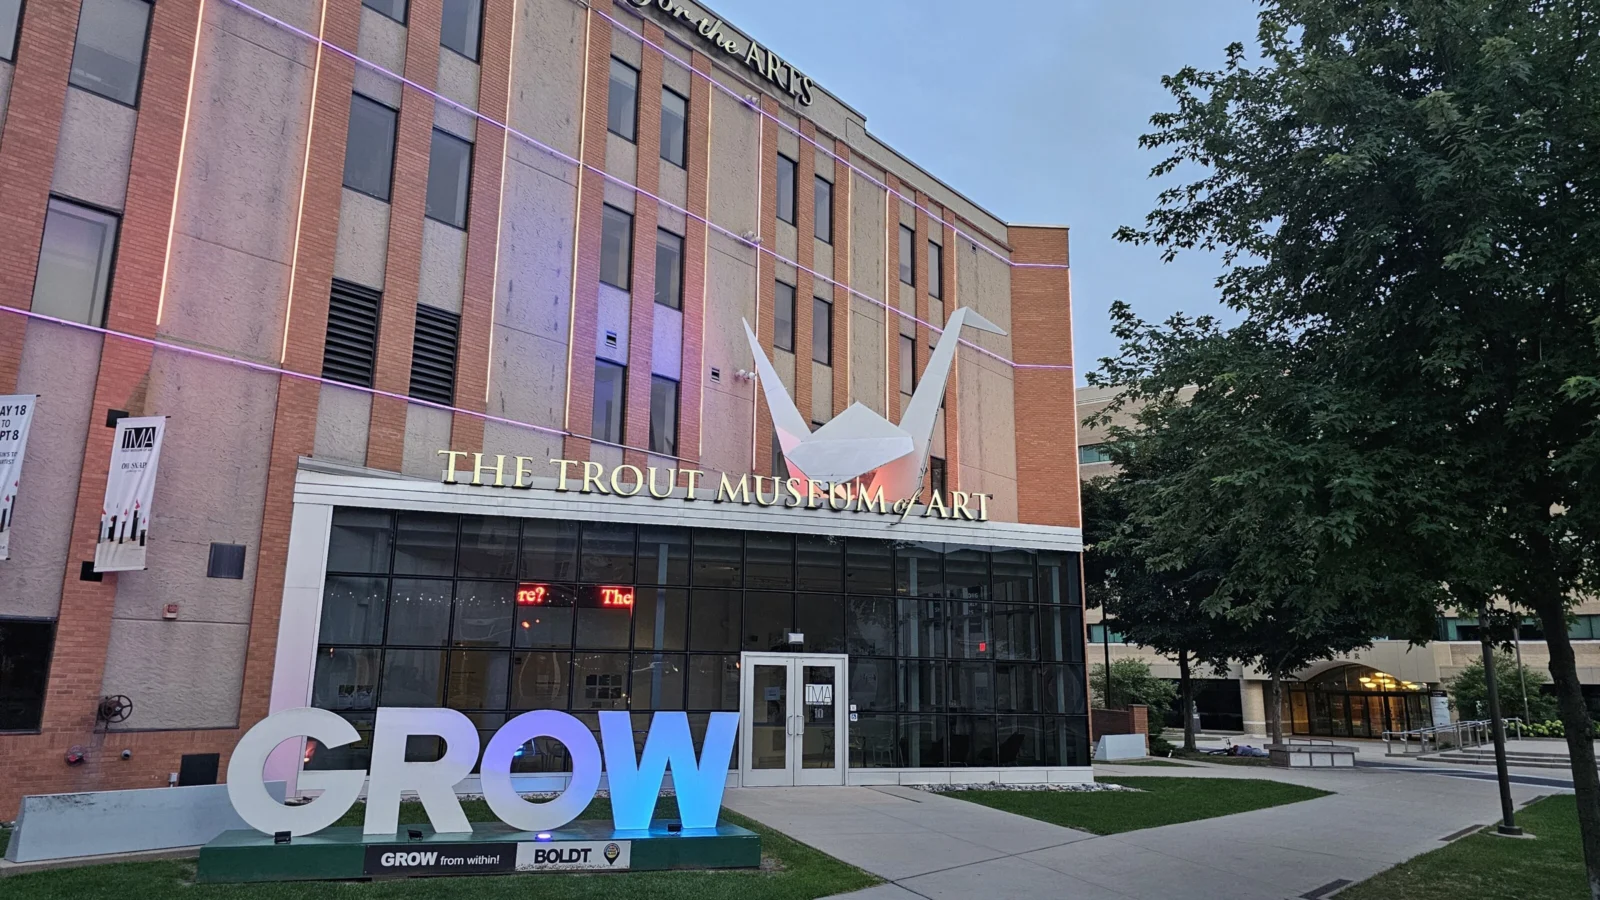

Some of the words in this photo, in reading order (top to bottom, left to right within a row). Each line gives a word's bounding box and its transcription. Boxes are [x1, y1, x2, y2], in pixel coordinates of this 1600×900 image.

[698, 18, 740, 54] the
[745, 41, 814, 106] ARTS
[0, 405, 12, 416] AY
[15, 405, 26, 415] 18
[1, 419, 10, 428] TO
[0, 430, 11, 440] PT
[12, 430, 19, 440] 8
[123, 427, 156, 448] TMA
[438, 450, 533, 489] THE
[550, 459, 704, 501] TROUT
[714, 471, 887, 514] MUSEUM
[889, 487, 924, 526] of
[922, 489, 994, 521] ART
[602, 588, 632, 605] The
[806, 685, 832, 703] TMA
[227, 707, 740, 837] GROW
[381, 852, 438, 867] GROW
[440, 855, 464, 865] from
[467, 854, 500, 865] within!
[534, 848, 592, 863] BOLDT
